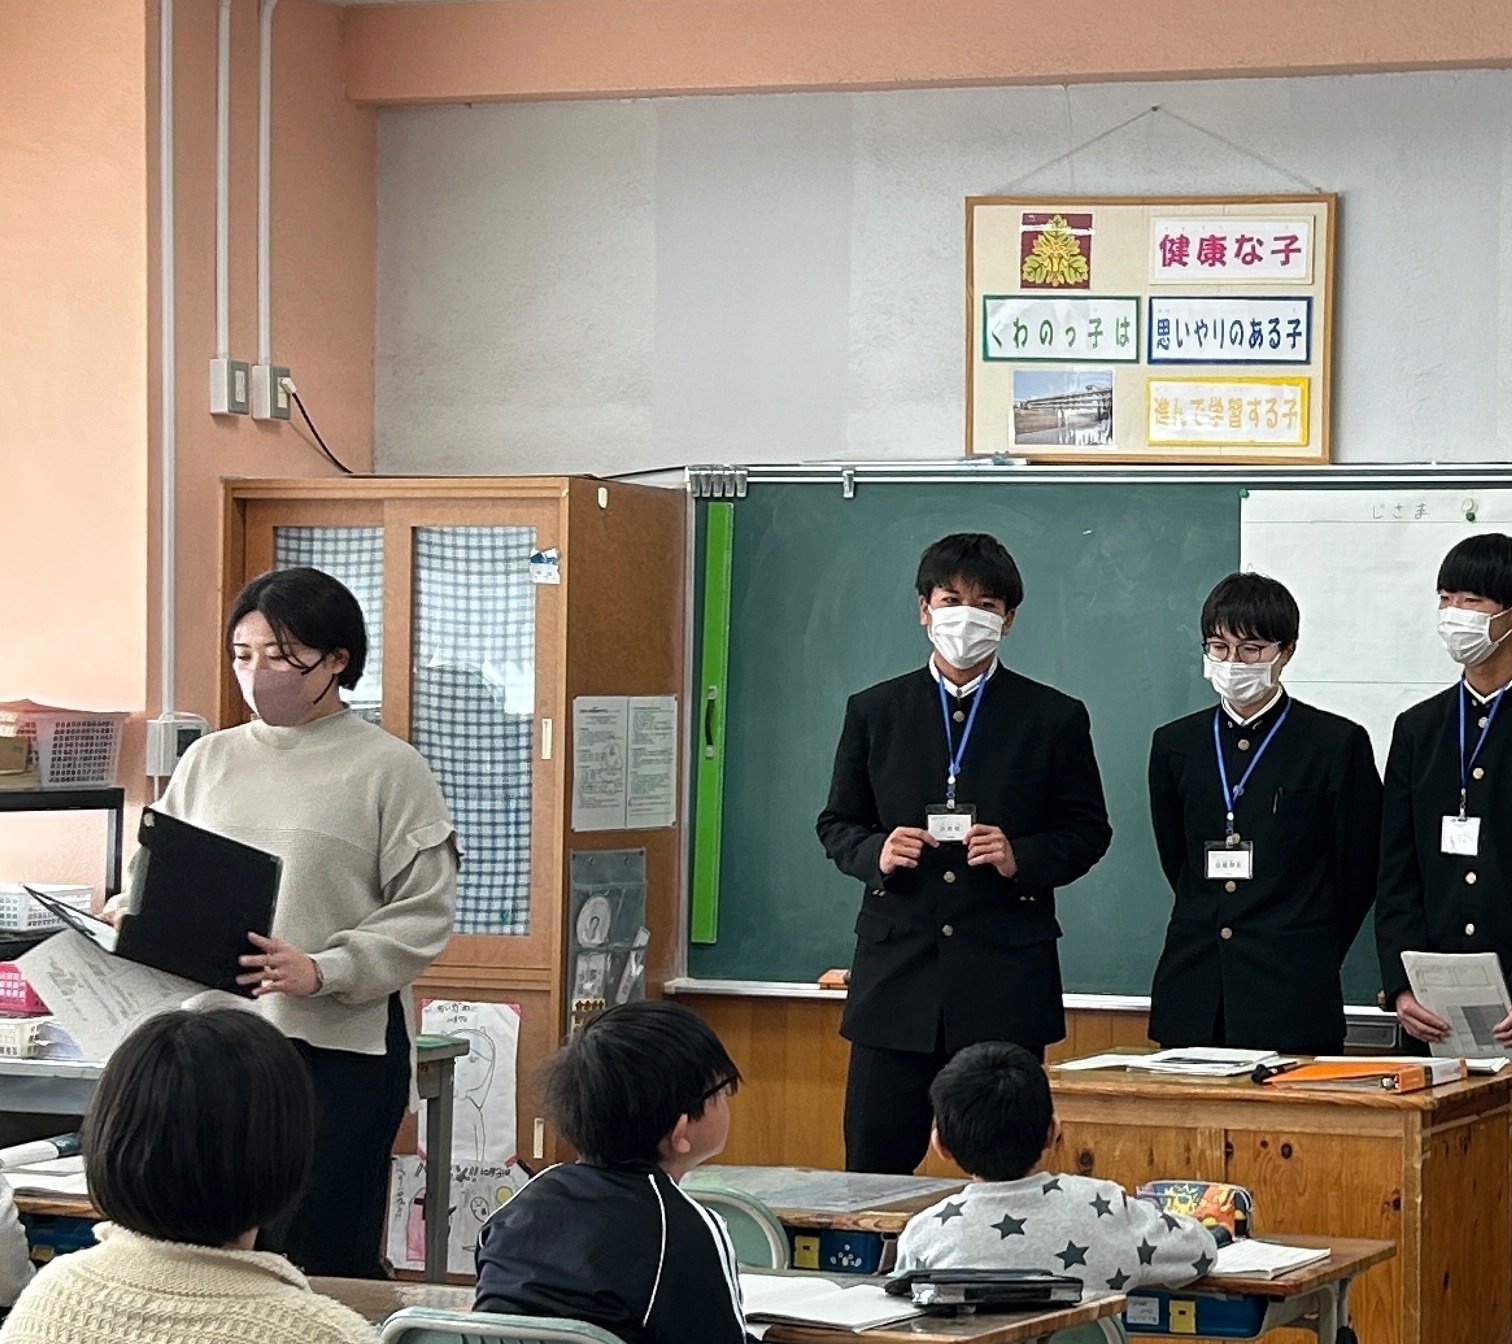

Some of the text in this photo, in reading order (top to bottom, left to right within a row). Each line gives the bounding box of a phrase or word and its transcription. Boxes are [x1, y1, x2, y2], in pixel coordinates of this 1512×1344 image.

[1159, 234, 1302, 267] 健康な子
[991, 317, 1131, 348] くわのっ子は
[1157, 317, 1303, 350] 思いやりのある子
